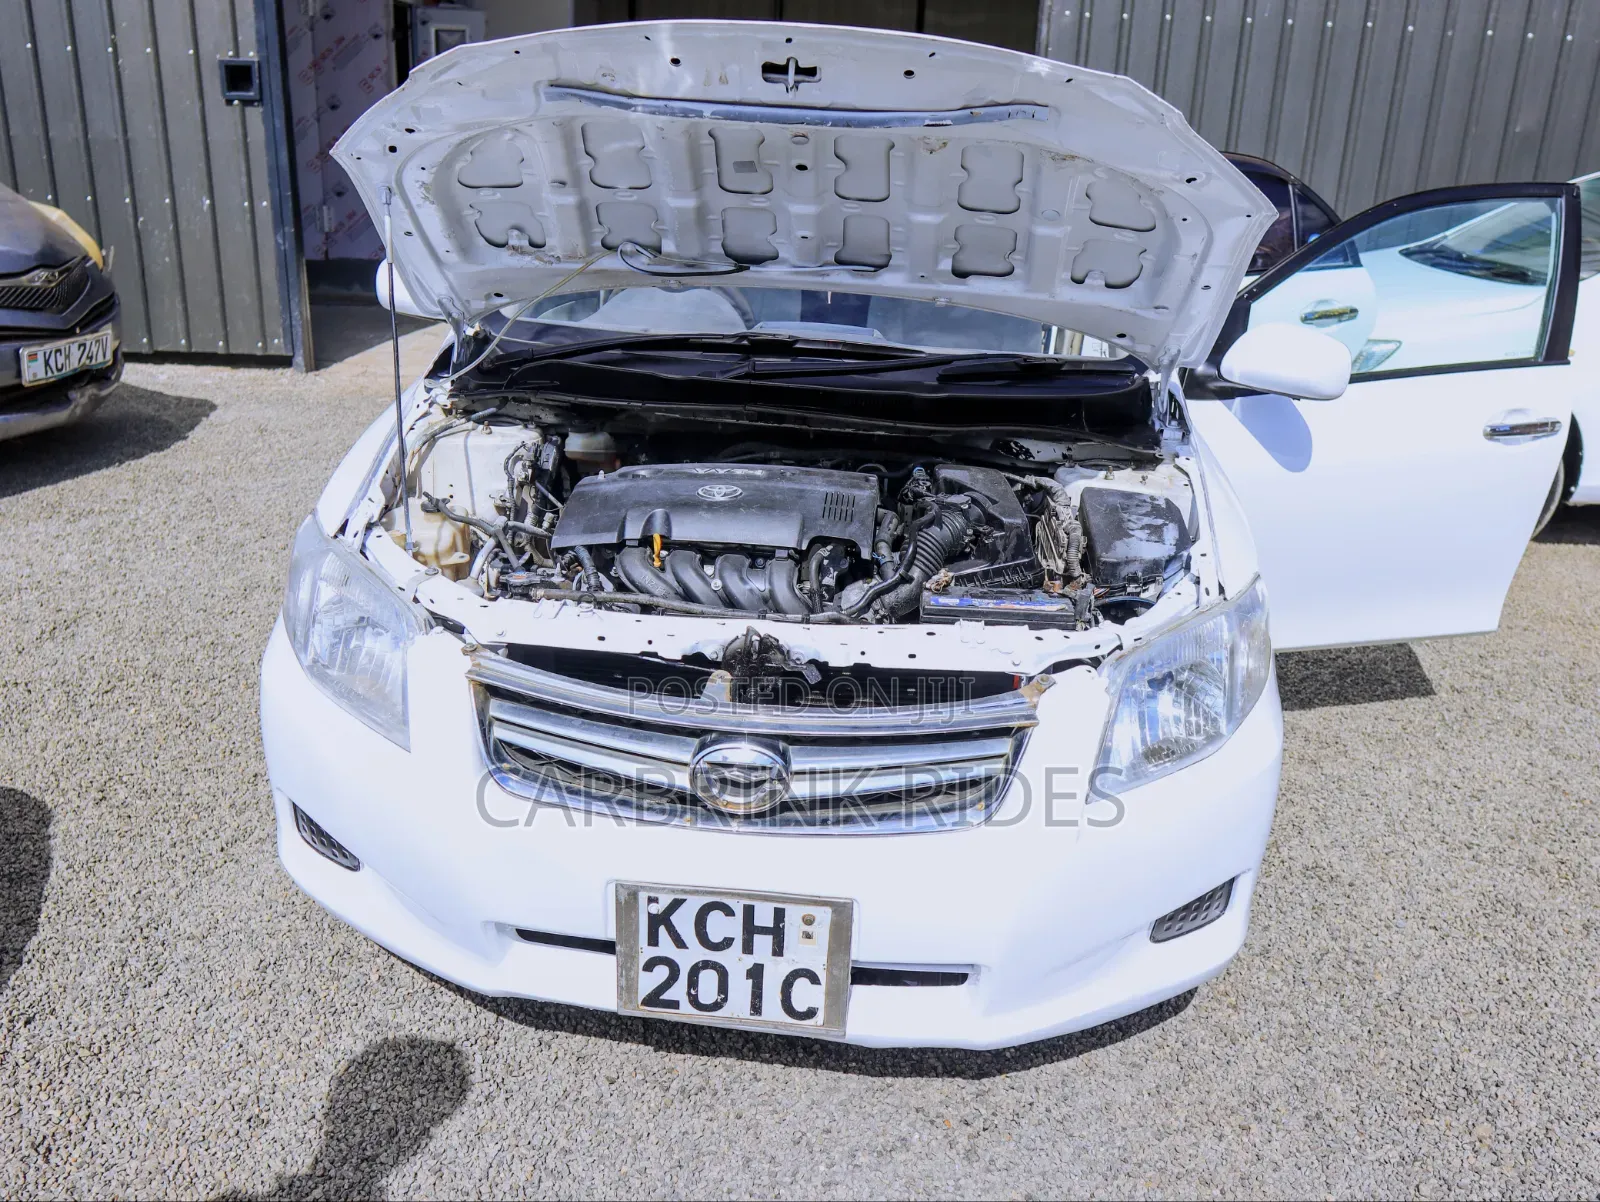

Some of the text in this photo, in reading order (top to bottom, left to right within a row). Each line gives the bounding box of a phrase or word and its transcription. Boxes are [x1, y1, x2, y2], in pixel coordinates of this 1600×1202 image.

[43, 345, 71, 376] KCH
[647, 895, 786, 957] KCH
[640, 955, 822, 1021] 201C
